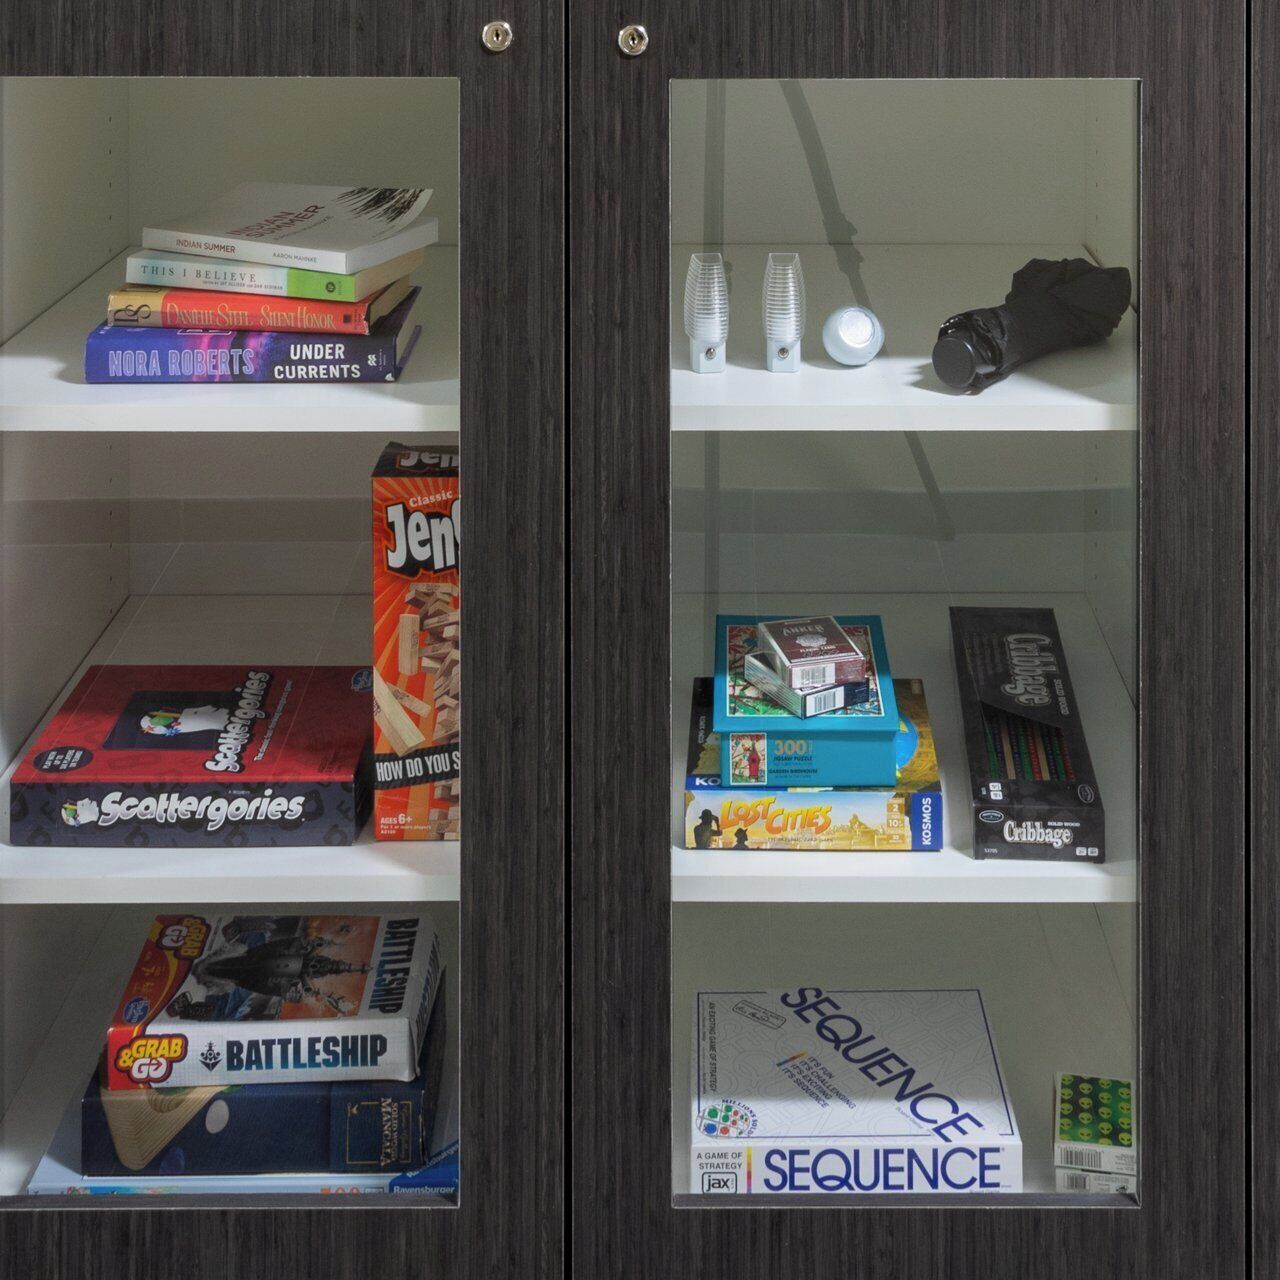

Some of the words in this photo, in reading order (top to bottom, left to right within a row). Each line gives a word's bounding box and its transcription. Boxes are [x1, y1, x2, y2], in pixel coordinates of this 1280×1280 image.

[244, 203, 326, 239] SUMMER
[176, 239, 202, 251] INDIAN
[203, 241, 236, 254] SUMMER
[272, 252, 292, 261] AARON
[140, 264, 175, 277] THIS
[195, 268, 257, 283] BELIEVE
[166, 302, 216, 328] DANIELLE
[216, 303, 252, 328] STEEL
[259, 304, 296, 328] SILENT
[296, 306, 336, 329] HONOR
[108, 348, 159, 377] NORA
[167, 348, 254, 376] ROBERTS
[290, 343, 345, 361] UNDER
[274, 363, 361, 380] CURRENTS
[409, 489, 454, 508] Classic
[386, 501, 460, 571] Jen
[782, 624, 824, 636] ANKER
[1001, 632, 1055, 706] Cribbage
[205, 669, 272, 772] Scattergories
[773, 739, 808, 755] 300
[376, 760, 403, 782] HOW
[405, 759, 423, 780] DO
[424, 758, 451, 778] YOU
[97, 787, 306, 831] Scattergories
[380, 816, 398, 824] AGES
[398, 813, 413, 825] 6+
[720, 796, 776, 829] LOST
[766, 805, 833, 835] CITIES
[921, 797, 932, 846] KOSMOS
[1003, 821, 1073, 849] Cribbage
[369, 917, 420, 1014] BATTLESHIP
[118, 1049, 134, 1070] &
[131, 1036, 183, 1060] GRAB
[226, 1033, 388, 1072] BATTLESHIP
[131, 1058, 169, 1080] GO
[780, 986, 984, 1144] SEQUENCE
[391, 1102, 399, 1130] SOLID
[380, 1096, 392, 1167] MANCALA
[391, 1132, 399, 1161] WOOD
[699, 1162, 743, 1170] STRATEGY
[764, 1147, 1001, 1192] SEQUENCE
[393, 1185, 455, 1195] Ravensburger
[705, 1174, 730, 1191] jax
